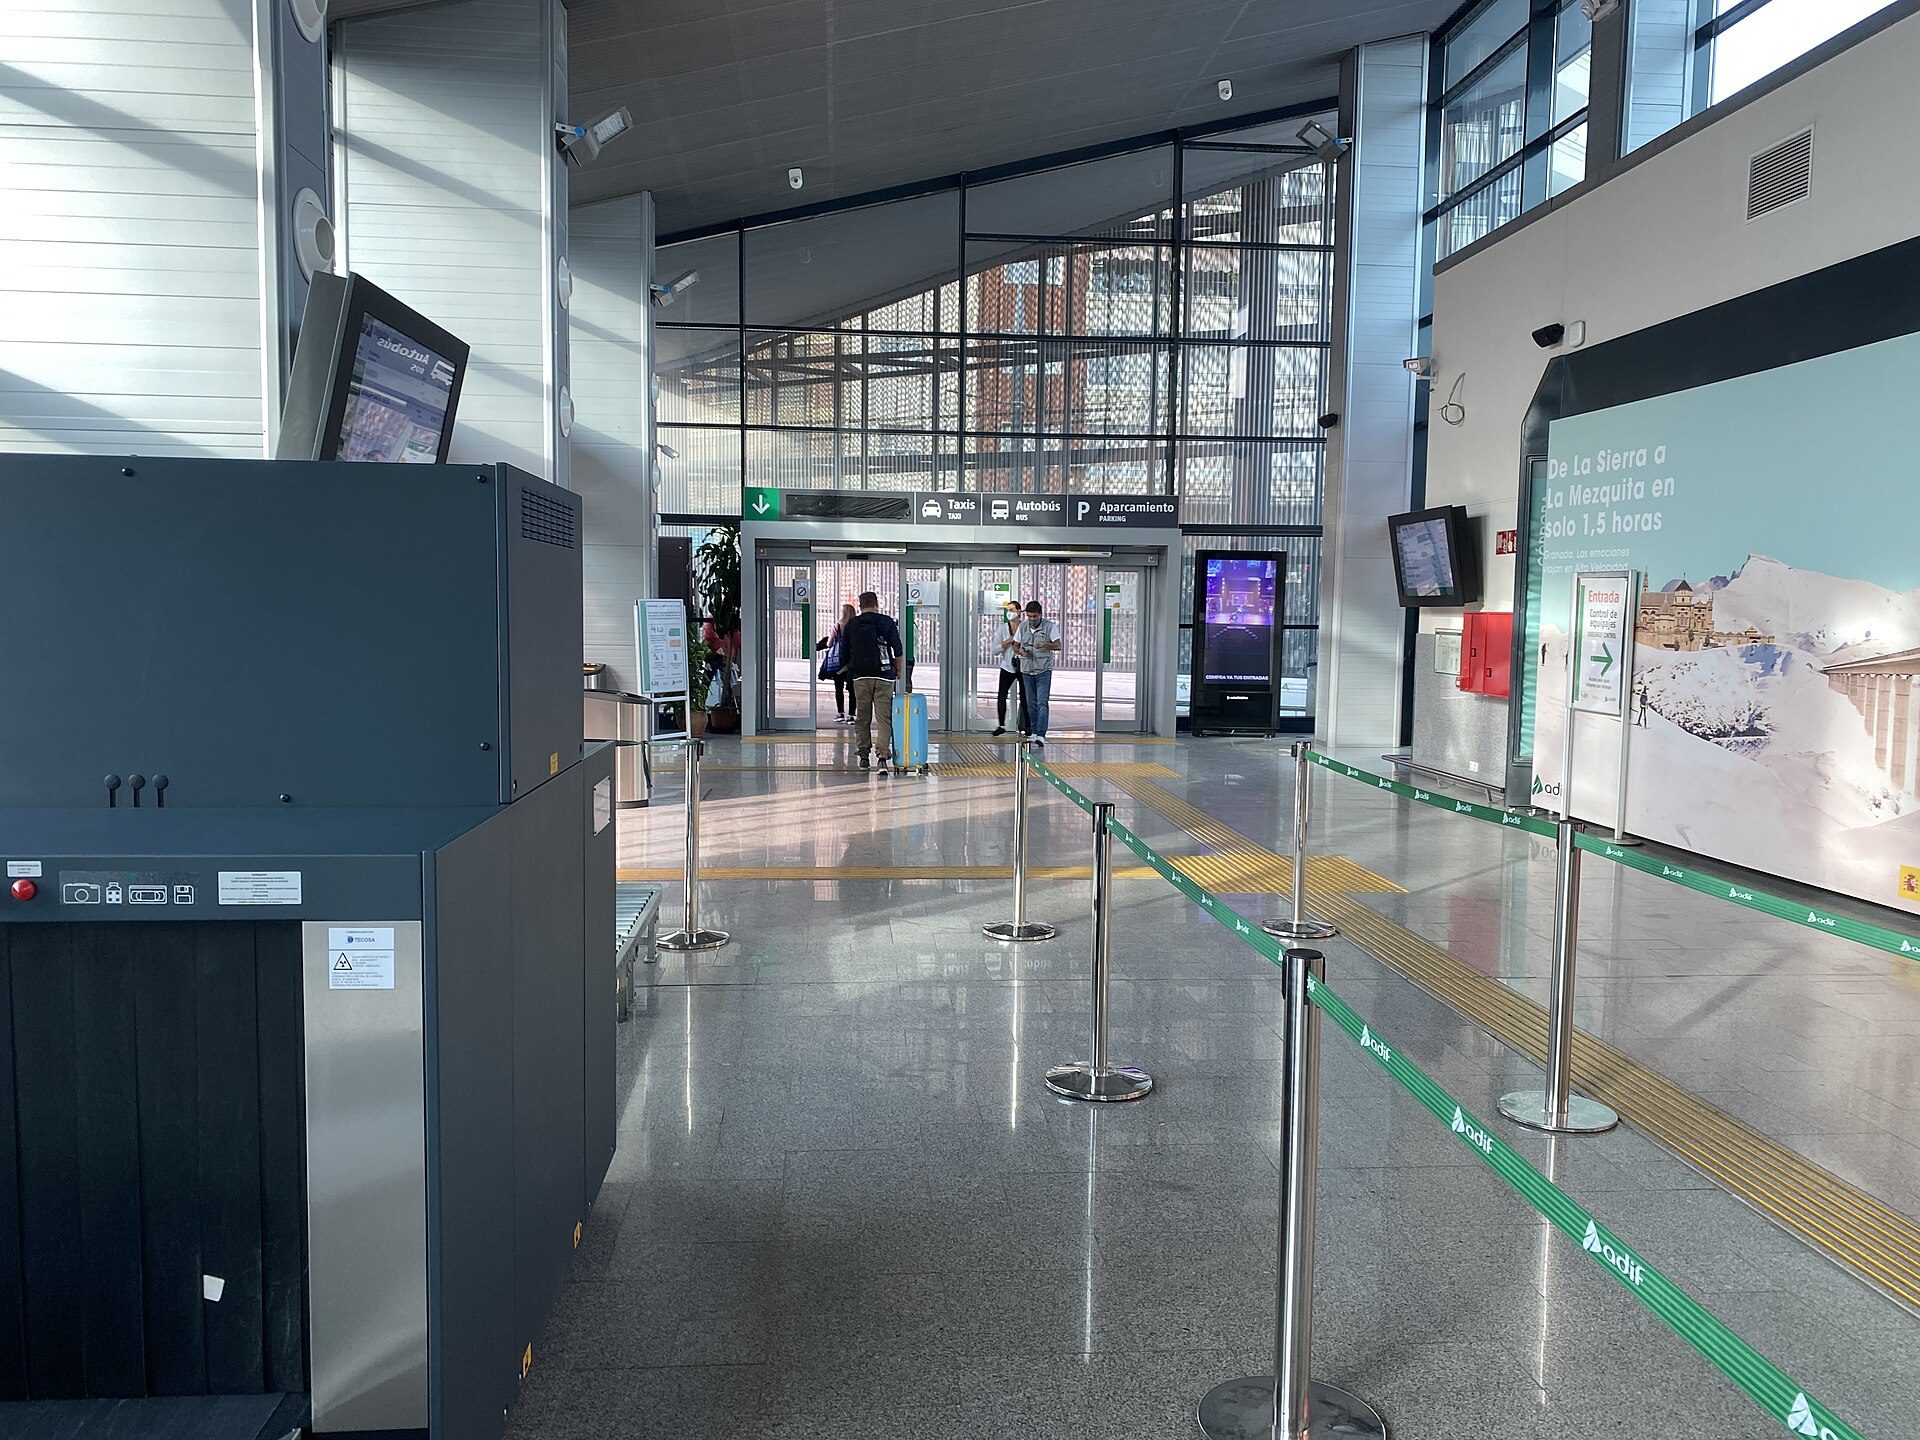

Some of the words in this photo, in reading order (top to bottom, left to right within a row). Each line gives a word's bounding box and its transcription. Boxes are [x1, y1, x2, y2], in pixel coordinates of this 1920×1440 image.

[1548, 458, 1568, 480] De
[1574, 454, 1591, 476] La
[1596, 448, 1647, 473] Sierra
[1654, 444, 1666, 465] a
[1547, 488, 1564, 509] La
[1569, 477, 1645, 508] Mezquita
[1652, 476, 1675, 498] en
[947, 498, 976, 510] Taxis
[1015, 500, 1061, 511] Autobús
[1099, 501, 1175, 514] Aparcamiento
[947, 512, 962, 520] TAXI
[1077, 501, 1090, 521] P
[1545, 515, 1576, 538] solo
[1582, 511, 1606, 537] 1,5
[1611, 510, 1662, 533] horas
[1576, 548, 1588, 559] Las
[1589, 547, 1630, 558] emociones
[1588, 590, 1620, 603] Entrada
[1589, 608, 1609, 618] Control
[1610, 609, 1618, 619] de
[1589, 619, 1616, 630] equipajes
[1370, 1038, 1391, 1063] adif
[1465, 1124, 1494, 1155] adif
[1603, 1244, 1646, 1286] adif
